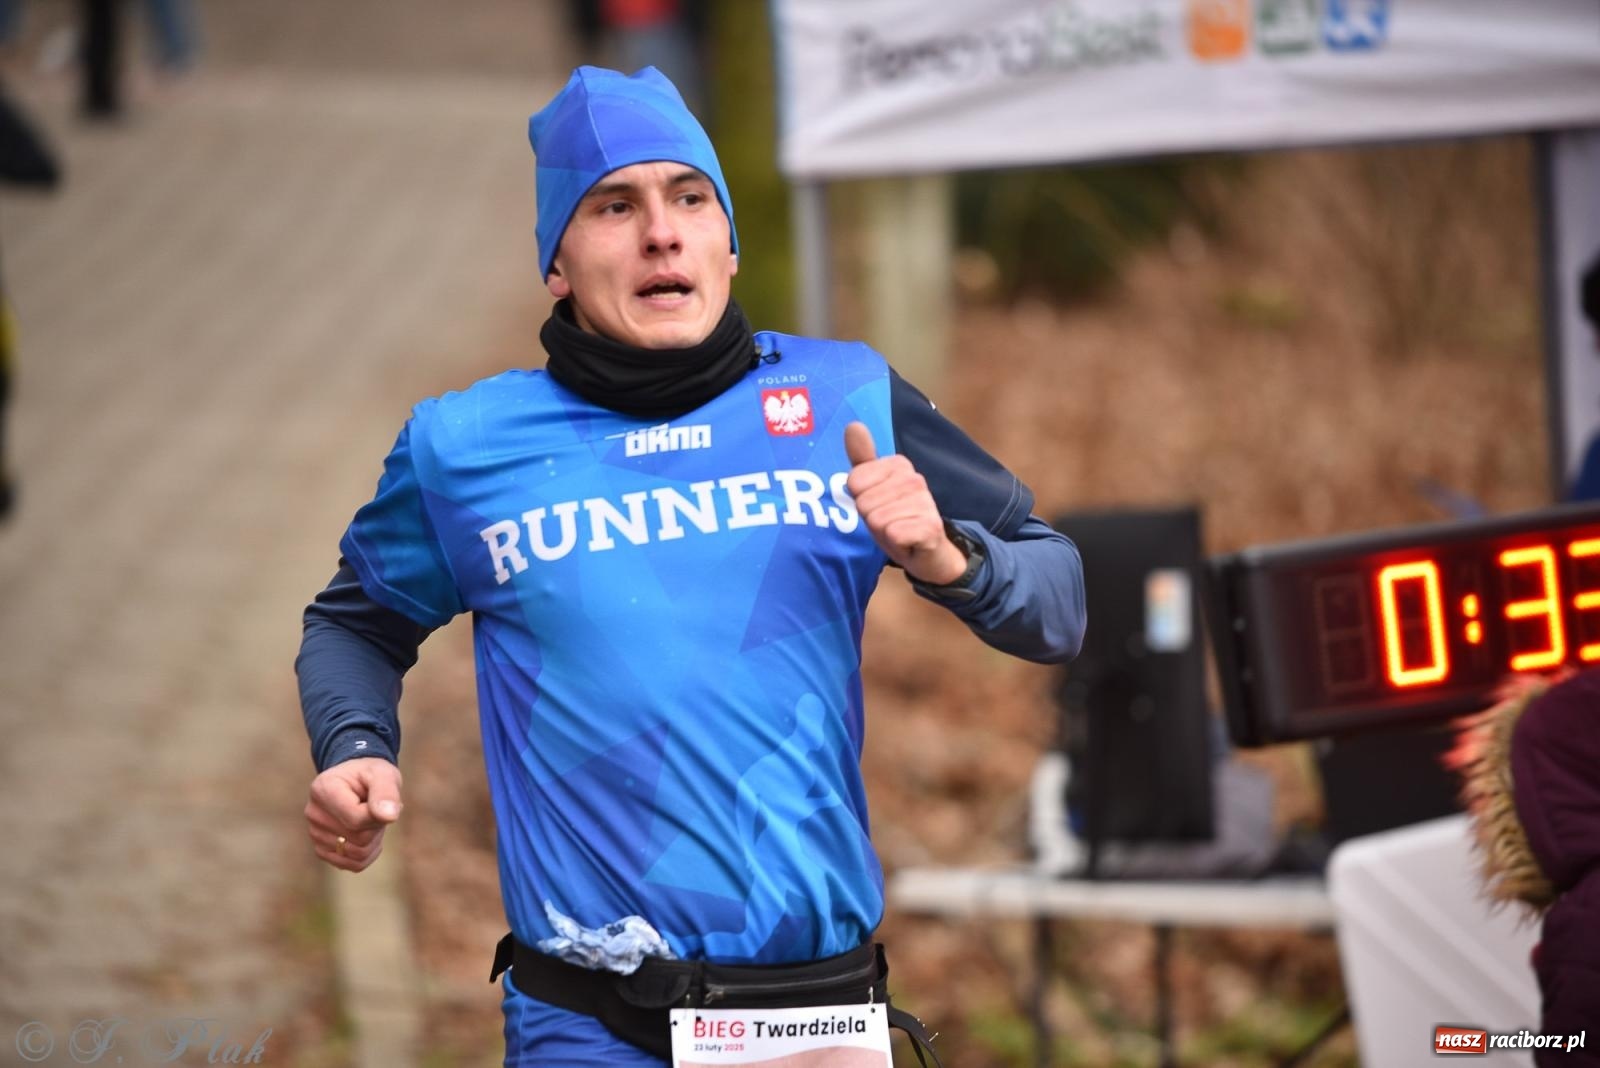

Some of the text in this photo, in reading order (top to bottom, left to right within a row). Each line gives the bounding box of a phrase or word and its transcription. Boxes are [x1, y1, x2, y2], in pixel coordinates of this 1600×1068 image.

[758, 374, 807, 385] POLAND
[480, 469, 859, 585] RUNNERS
[694, 1016, 867, 1038] BIEG Twardziela
[705, 1043, 722, 1053] luty
[725, 1043, 744, 1051] 2025
